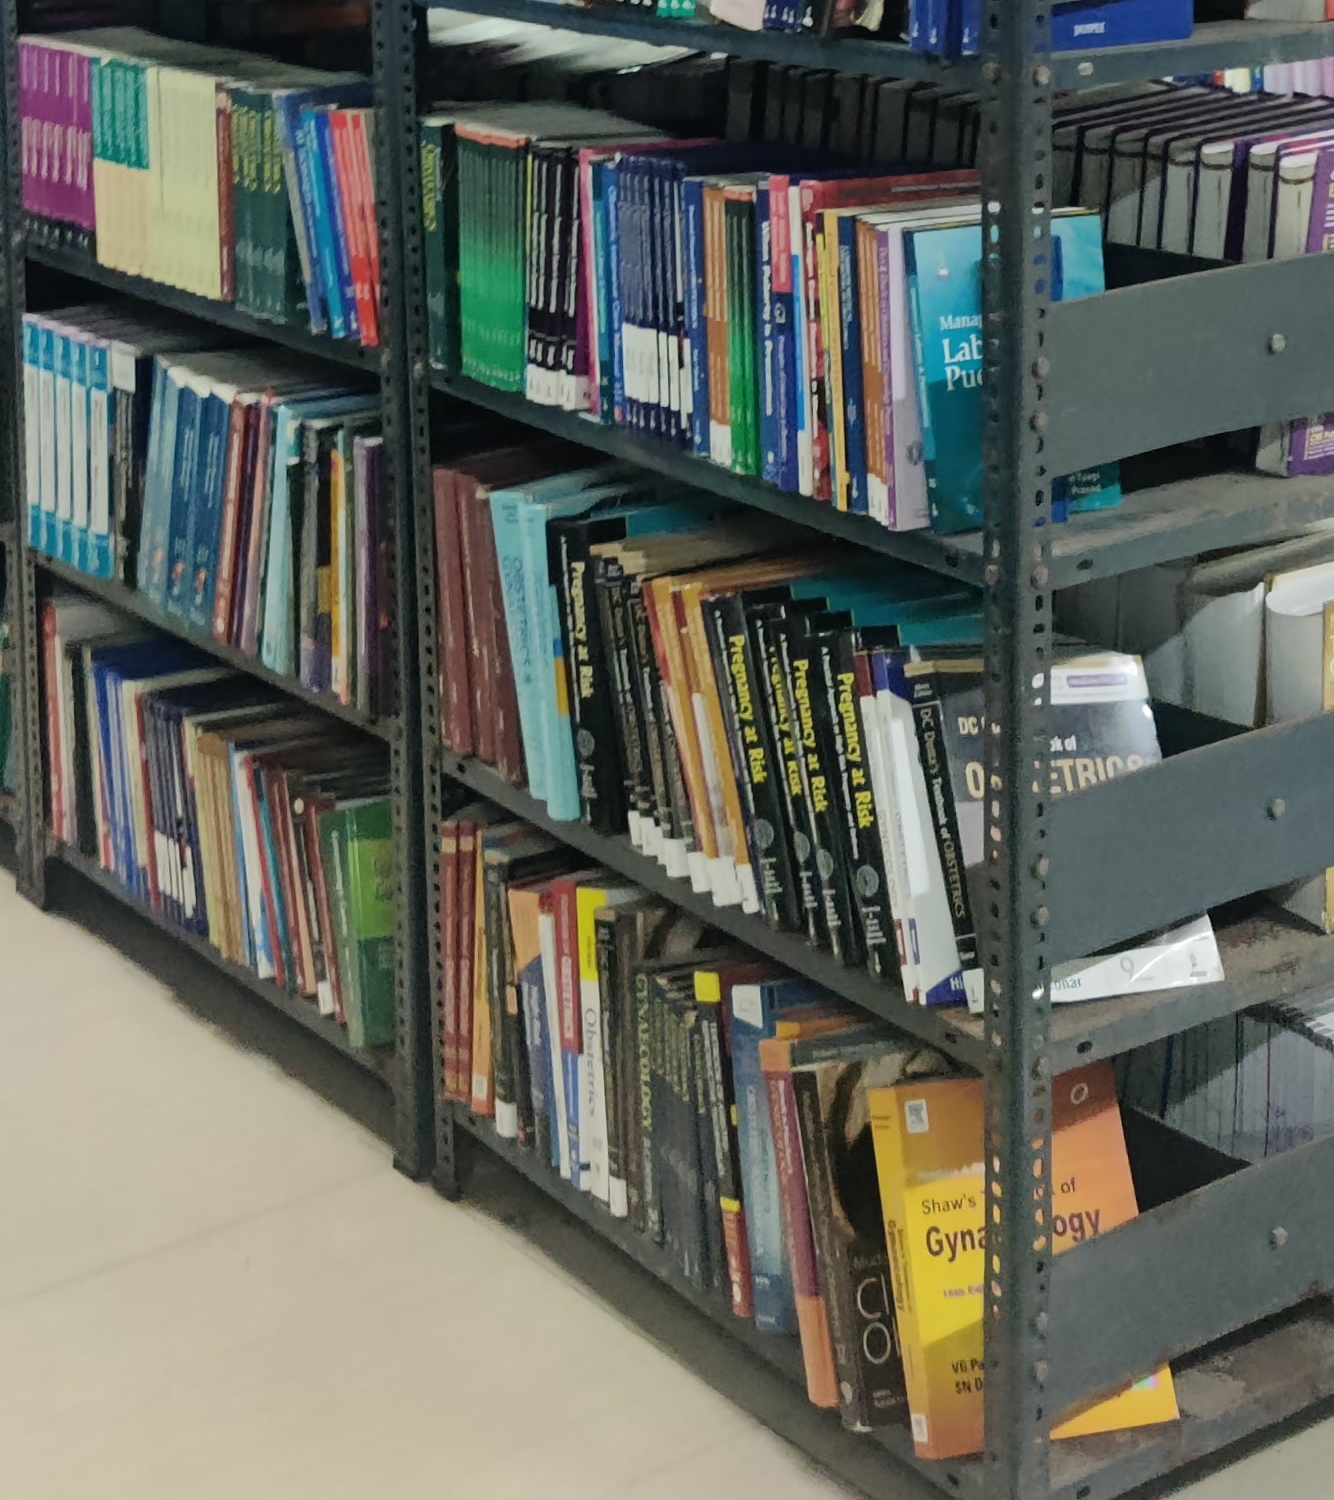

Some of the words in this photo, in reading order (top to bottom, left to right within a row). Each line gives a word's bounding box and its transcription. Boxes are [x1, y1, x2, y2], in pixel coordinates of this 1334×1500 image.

[939, 314, 983, 331] Mana
[942, 334, 983, 364] Lab
[571, 561, 587, 642] Pregnancy
[578, 644, 589, 661] at
[580, 665, 595, 698] Risk
[729, 634, 753, 721] Pregnancy
[793, 659, 817, 748] Pregnancy
[837, 673, 862, 762] Pregnancy
[744, 725, 759, 744] at
[957, 716, 979, 735] DC
[748, 747, 767, 785] Risk
[807, 753, 820, 771] at
[851, 768, 866, 786] at
[811, 775, 828, 813] Risk
[854, 791, 875, 829] Risk
[920, 708, 934, 727] DC
[942, 839, 966, 918] OBSTETRICS
[1055, 977, 1082, 991] onar
[585, 1007, 597, 1117] Obstetrics
[1060, 1177, 1076, 1195] of
[921, 1194, 976, 1215] Shaw's
